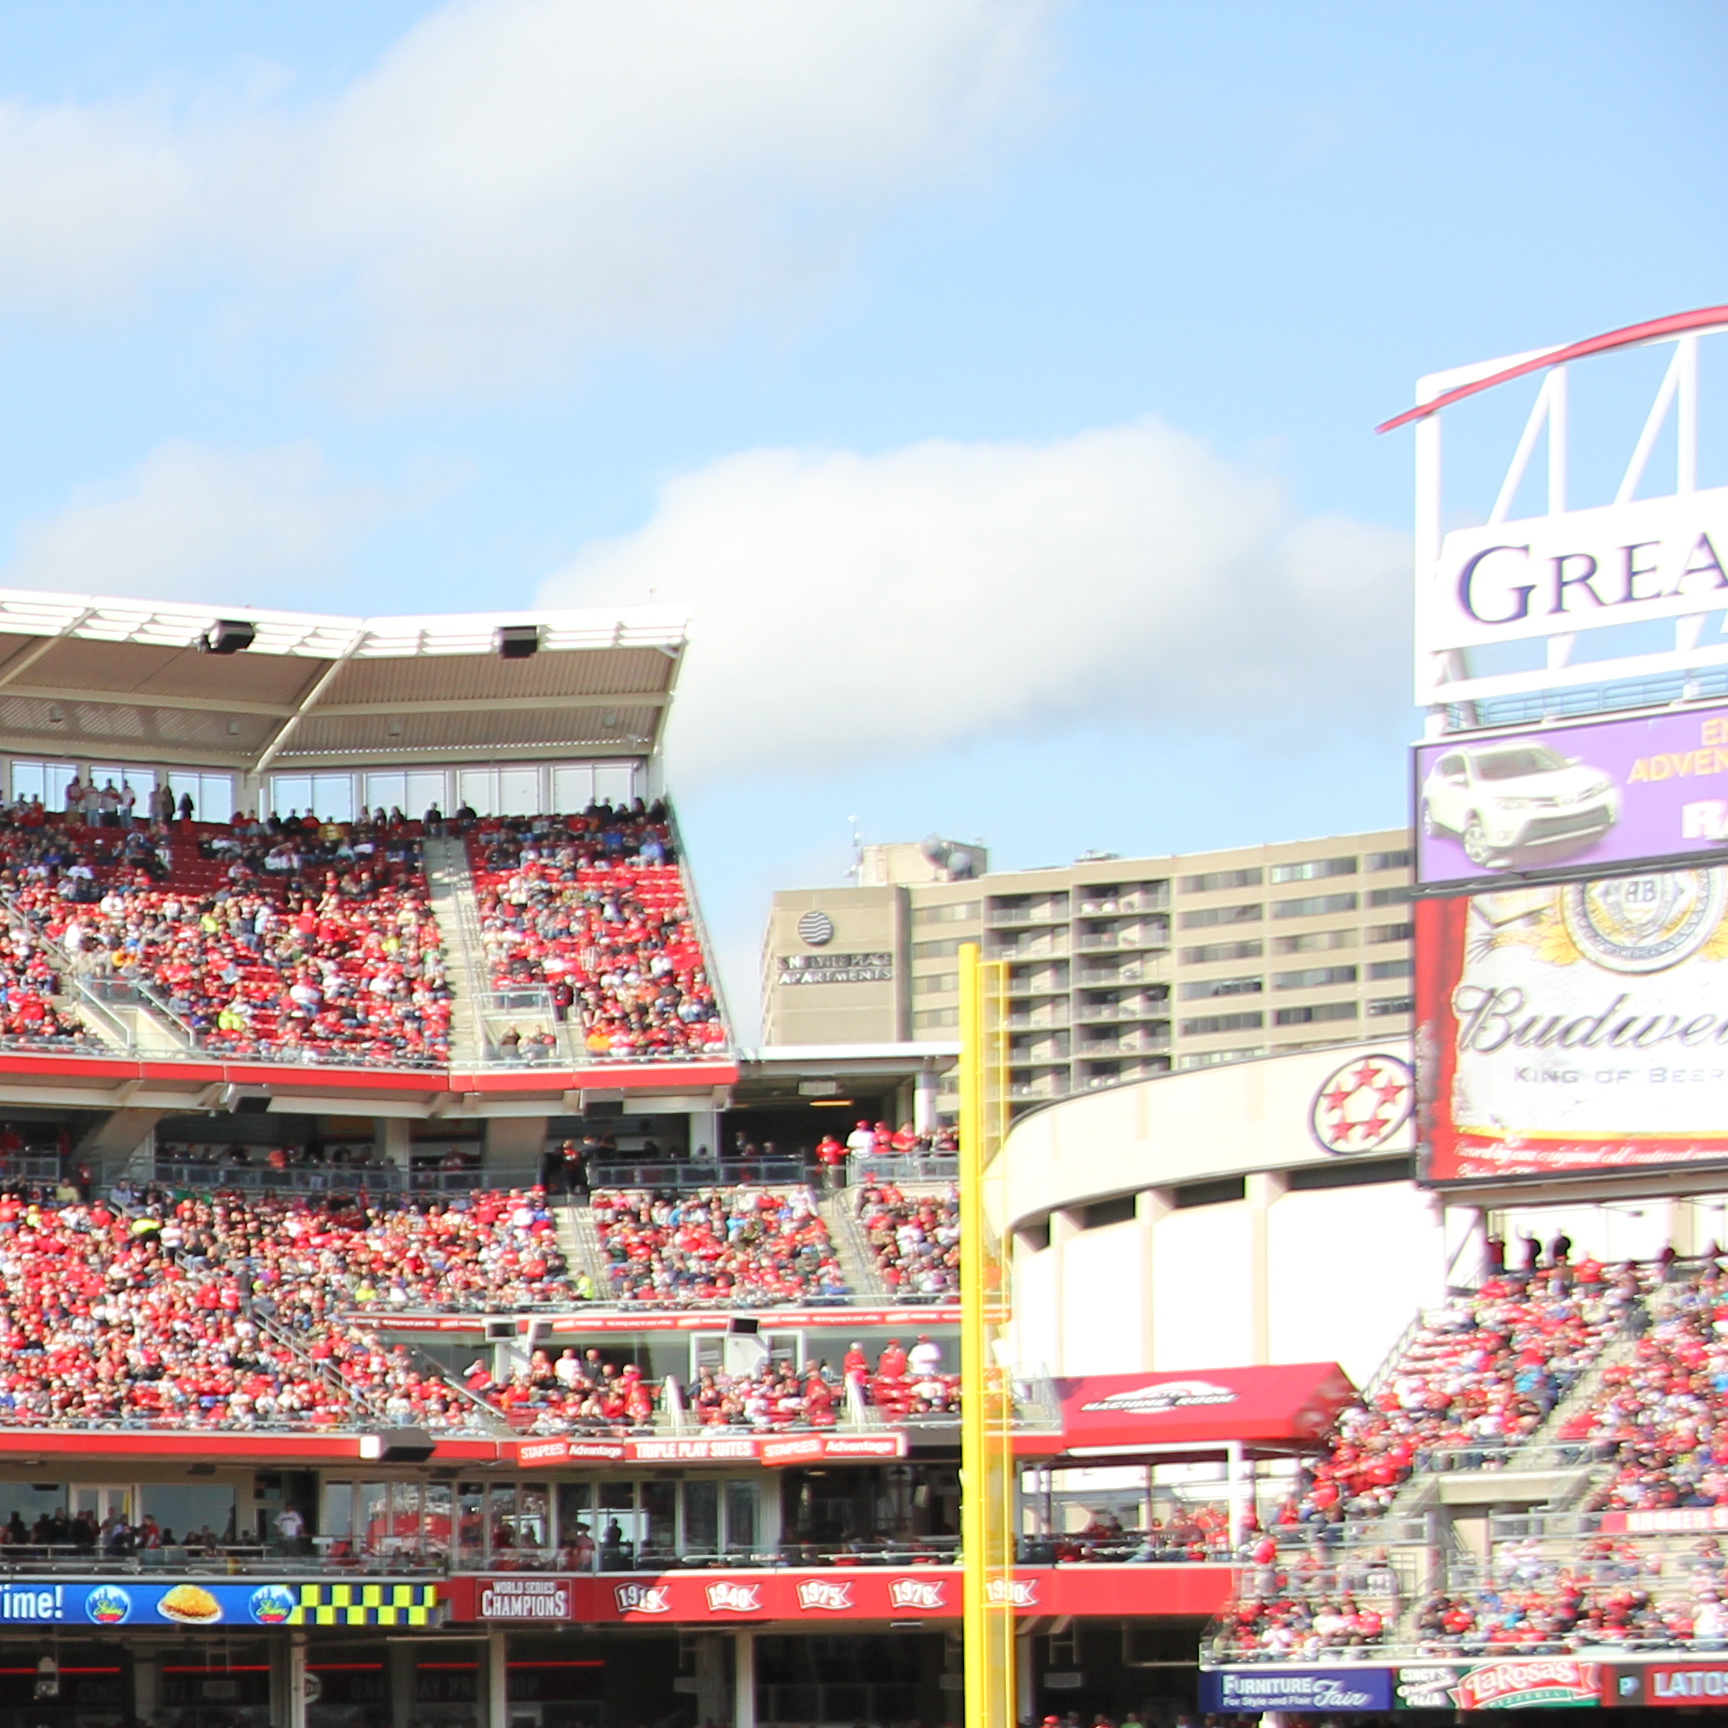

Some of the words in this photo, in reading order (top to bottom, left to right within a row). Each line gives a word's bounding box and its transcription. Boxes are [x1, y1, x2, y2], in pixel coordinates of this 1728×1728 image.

[778, 968, 893, 985] APARTMENTS
[1175, 1393, 1240, 1406] ROOM
[520, 1443, 564, 1459] STAPLES
[569, 1444, 622, 1458] Advantage
[635, 1442, 675, 1459] TRIPLE
[678, 1441, 707, 1458] PLAY
[710, 1440, 752, 1457] SUITES
[763, 1441, 819, 1457] STAPLES
[825, 1440, 892, 1455] Advantage
[492, 1582, 523, 1594] WORLD
[524, 1581, 556, 1594] SERIES
[708, 1582, 750, 1607] 1940
[800, 1582, 841, 1607] 1975
[893, 1581, 934, 1606] 1976
[481, 1591, 566, 1618] CHAMPIONS
[618, 1585, 659, 1610] 1919
[1222, 1675, 1313, 1695] FURNITURE
[1312, 1679, 1373, 1707] Fair
[1223, 1697, 1241, 1706] For
[1242, 1697, 1266, 1708] Style
[1268, 1697, 1286, 1706] and
[1288, 1696, 1312, 1706] Flair
